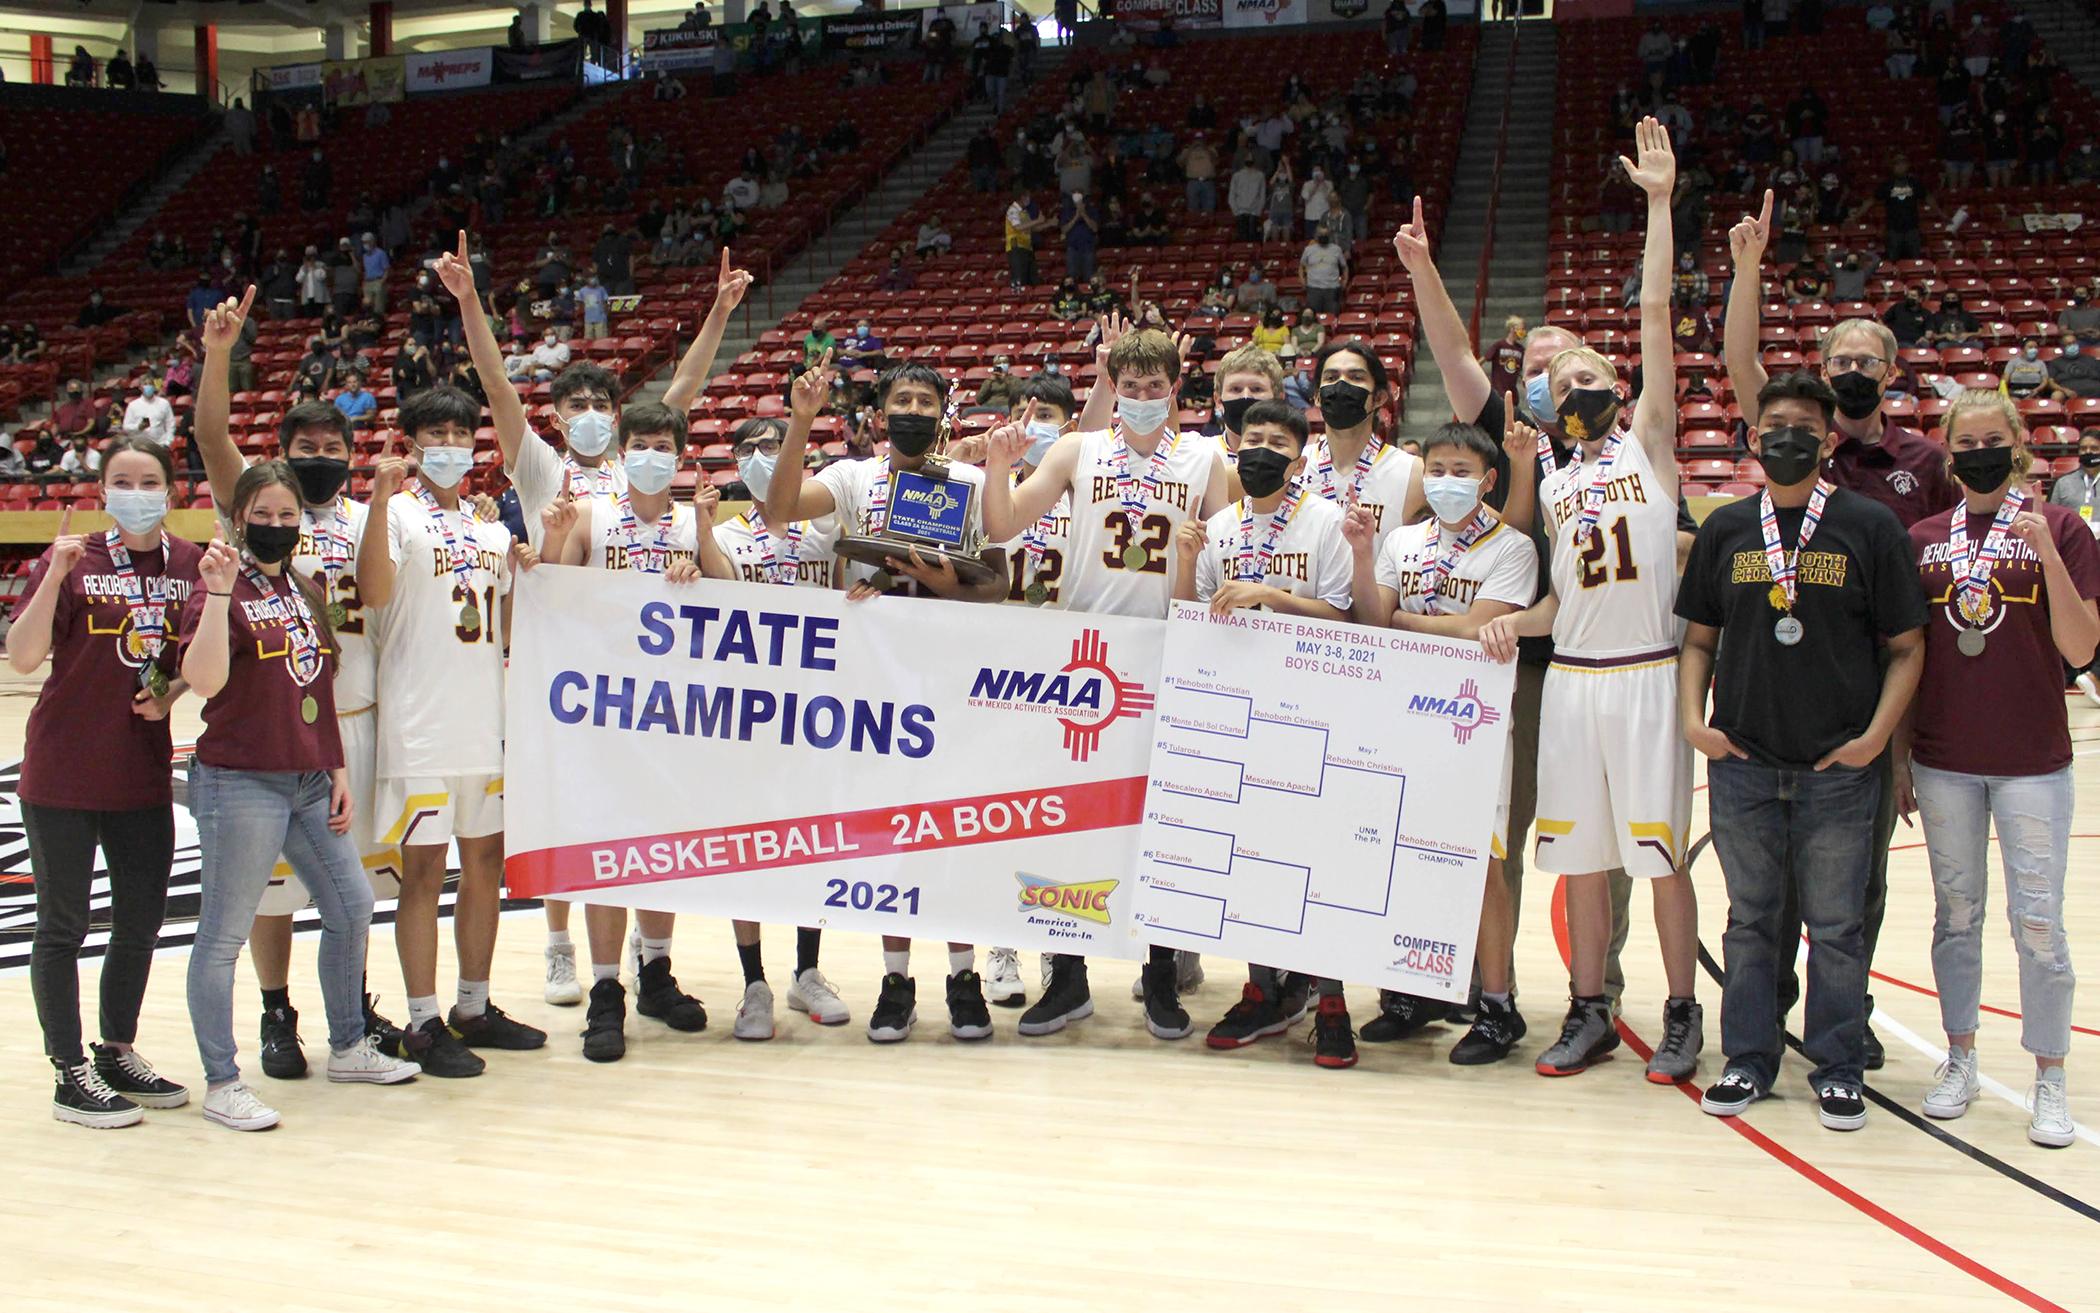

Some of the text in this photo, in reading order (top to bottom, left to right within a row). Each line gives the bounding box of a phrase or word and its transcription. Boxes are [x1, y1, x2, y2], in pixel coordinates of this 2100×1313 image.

[1175, 0, 1218, 15] CLASS
[659, 29, 719, 45] KUKULSKI
[902, 489, 943, 505] NMAA
[892, 514, 960, 531] STATE CHAMPIONS
[921, 524, 957, 536] BASKETBALL
[1102, 510, 1171, 575] 32
[1572, 514, 1638, 589] 21
[1007, 547, 1064, 602] 12
[1222, 552, 1308, 582] REBOTH
[451, 584, 495, 645] 31
[637, 600, 840, 672] STATE
[1177, 608, 1205, 622] 2021
[1209, 614, 1248, 628] NMAA
[1251, 618, 1293, 635] STATE
[1296, 625, 1386, 649] BASKETBALL
[1295, 640, 1376, 664] MAY 3-8, 2021
[1197, 668, 1213, 677] May
[1285, 656, 1382, 682] BOYS CLASS 2A
[969, 667, 1102, 709] NMAA
[1164, 676, 1251, 696] #1 Rehoboth Christian
[549, 669, 936, 759] CHAMPIONS
[967, 698, 1099, 719] NEW MEXICO ACTIVITIES ASSOCIATION
[1279, 701, 1293, 711] May
[1408, 694, 1475, 719] NMAA
[1160, 714, 1246, 735] #8 Monte Del Sol Charter
[1253, 709, 1330, 728] Rehoboth Christian
[1157, 741, 1201, 755] #5 Tularosa
[1358, 746, 1372, 755] May
[1326, 754, 1403, 774] Rehoboth Christian
[1152, 779, 1233, 799] #4 Mescalero Apache
[1245, 774, 1316, 793] Mescalero Apache
[1148, 812, 1184, 824] #3 Pecos
[592, 794, 1067, 881] BASKETBALL 2A BOYS
[1354, 833, 1381, 845] The Pit
[1359, 826, 1378, 836] UNM
[1236, 846, 1260, 857] Pecos
[1398, 834, 1477, 855] Rehoboth Christian
[1143, 850, 1193, 864] #6 Escalante
[1418, 853, 1464, 868] CHAMPION
[1139, 875, 1176, 888] #7 Texico
[824, 877, 922, 915] 2021
[1022, 883, 1111, 911] SONIC
[1308, 890, 1321, 899] Jal
[1027, 916, 1078, 928] America's
[1134, 913, 1160, 924] #2 Jal
[1227, 911, 1240, 920] Jal
[1048, 928, 1092, 940] Drive-In
[1393, 934, 1457, 957] COMPETE
[1406, 949, 1454, 976] CLASS
